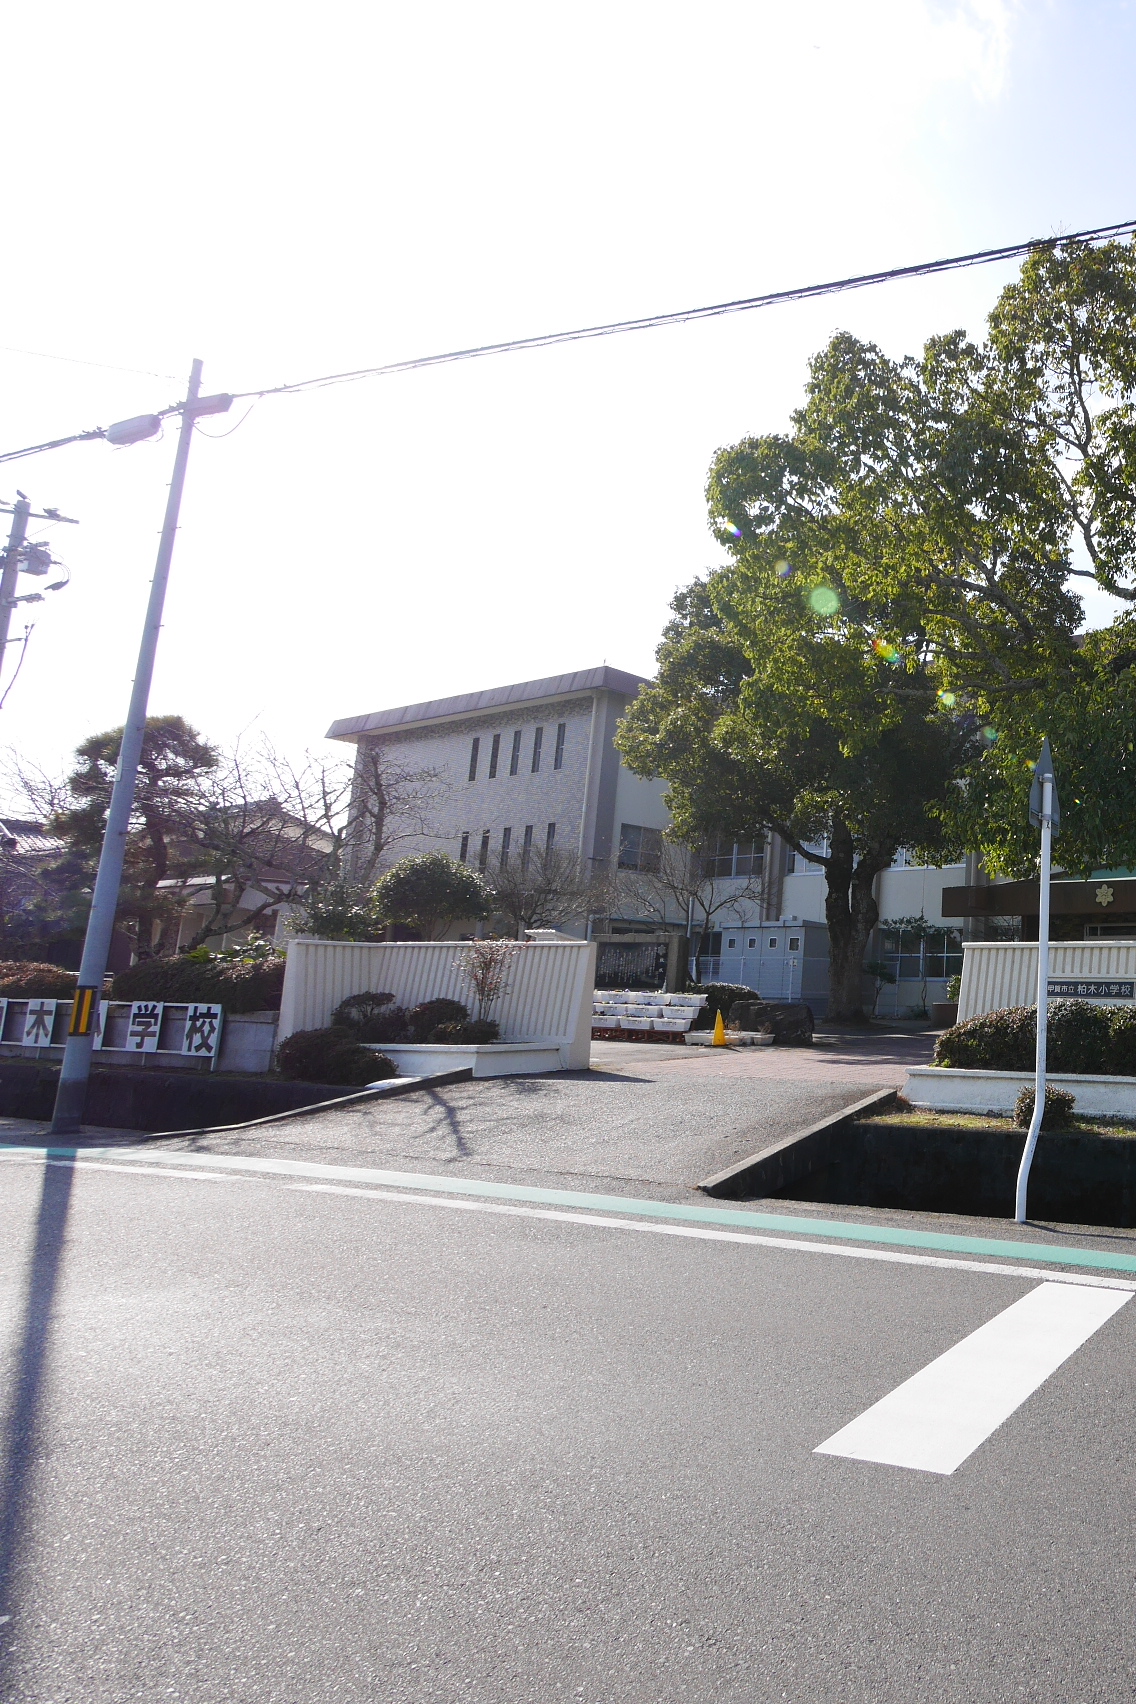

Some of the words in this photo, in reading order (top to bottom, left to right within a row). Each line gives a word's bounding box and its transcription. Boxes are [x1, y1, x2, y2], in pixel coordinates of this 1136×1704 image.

[1077, 983, 1131, 996] 柏木小学校
